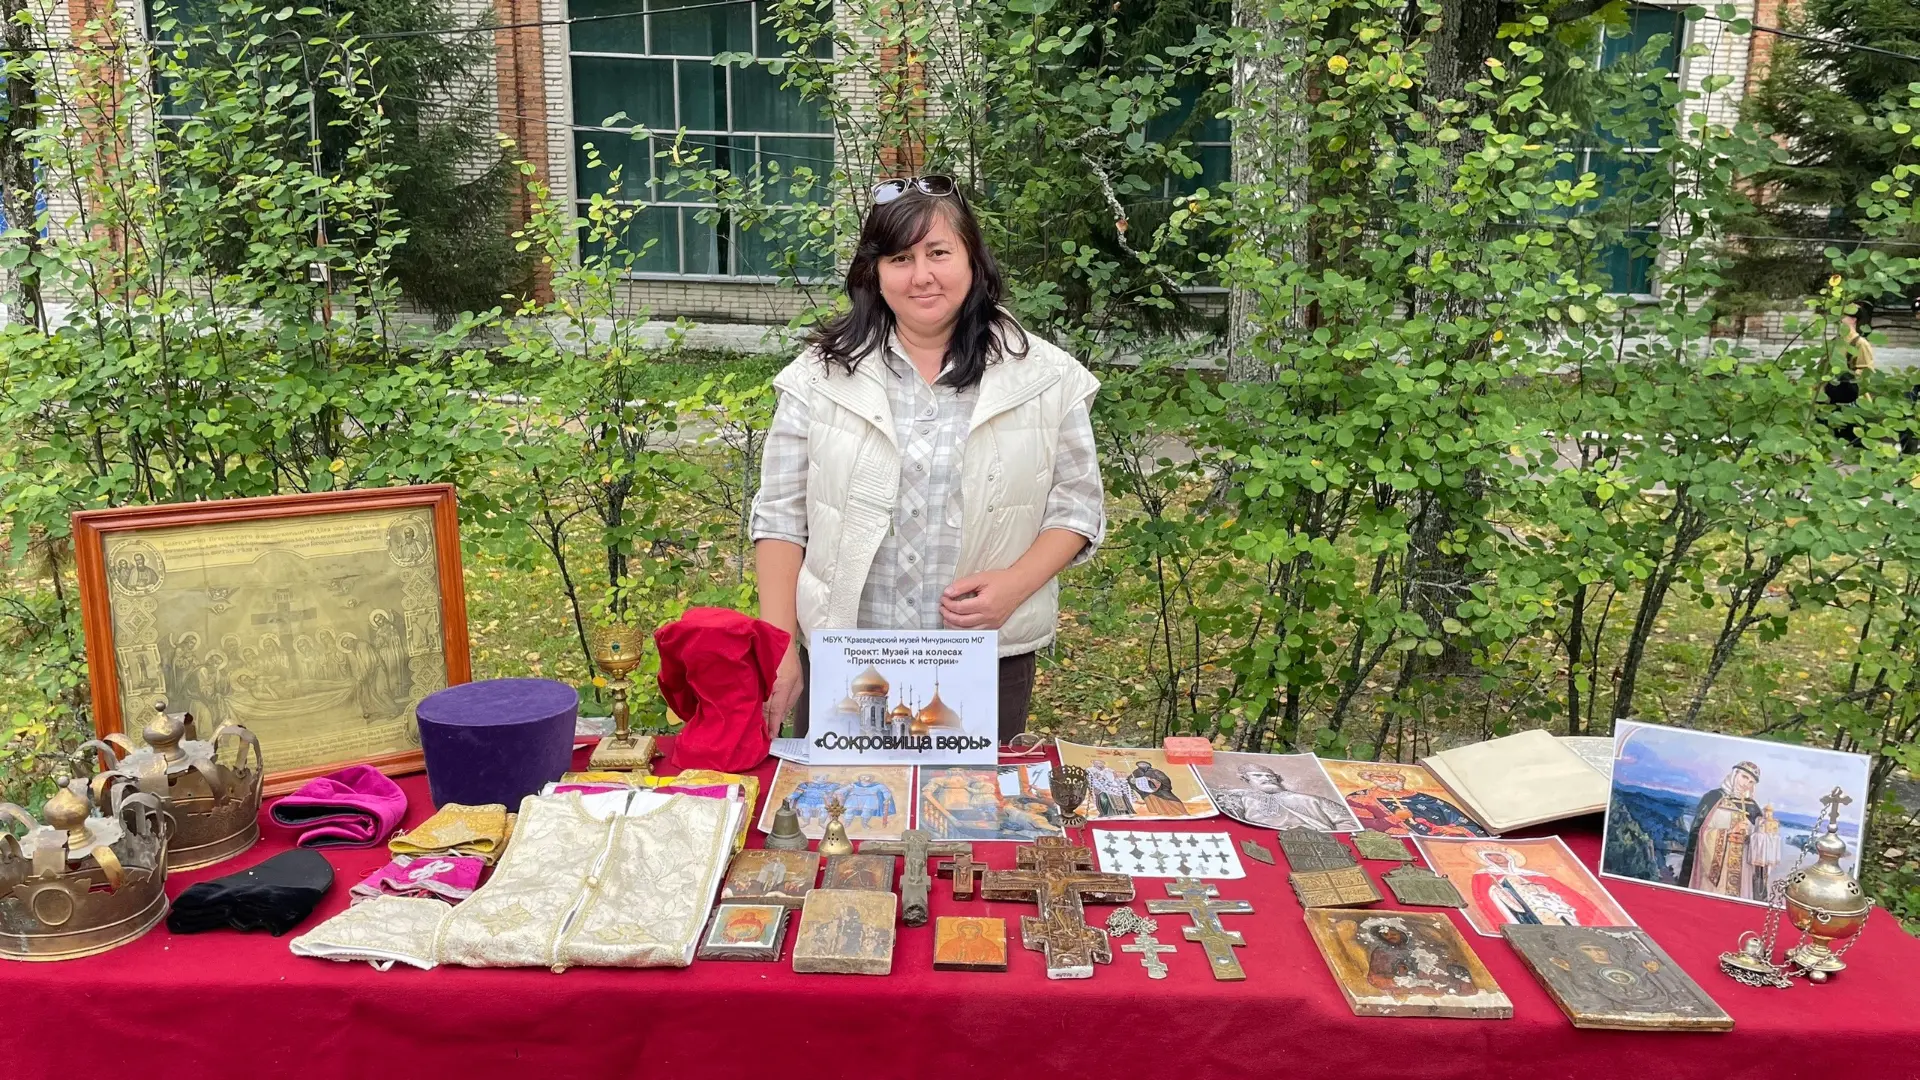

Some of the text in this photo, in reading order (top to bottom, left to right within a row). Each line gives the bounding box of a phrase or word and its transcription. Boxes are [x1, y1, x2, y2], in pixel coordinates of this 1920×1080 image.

[822, 635, 985, 645] МБУК "Краеведческий музей Мичуринского МО"
[844, 647, 880, 657] Проект:
[881, 647, 910, 657] Музей
[846, 657, 907, 666] «Прикоснись
[917, 658, 959, 666] истории»
[814, 731, 992, 754] «Сокровища веры»
